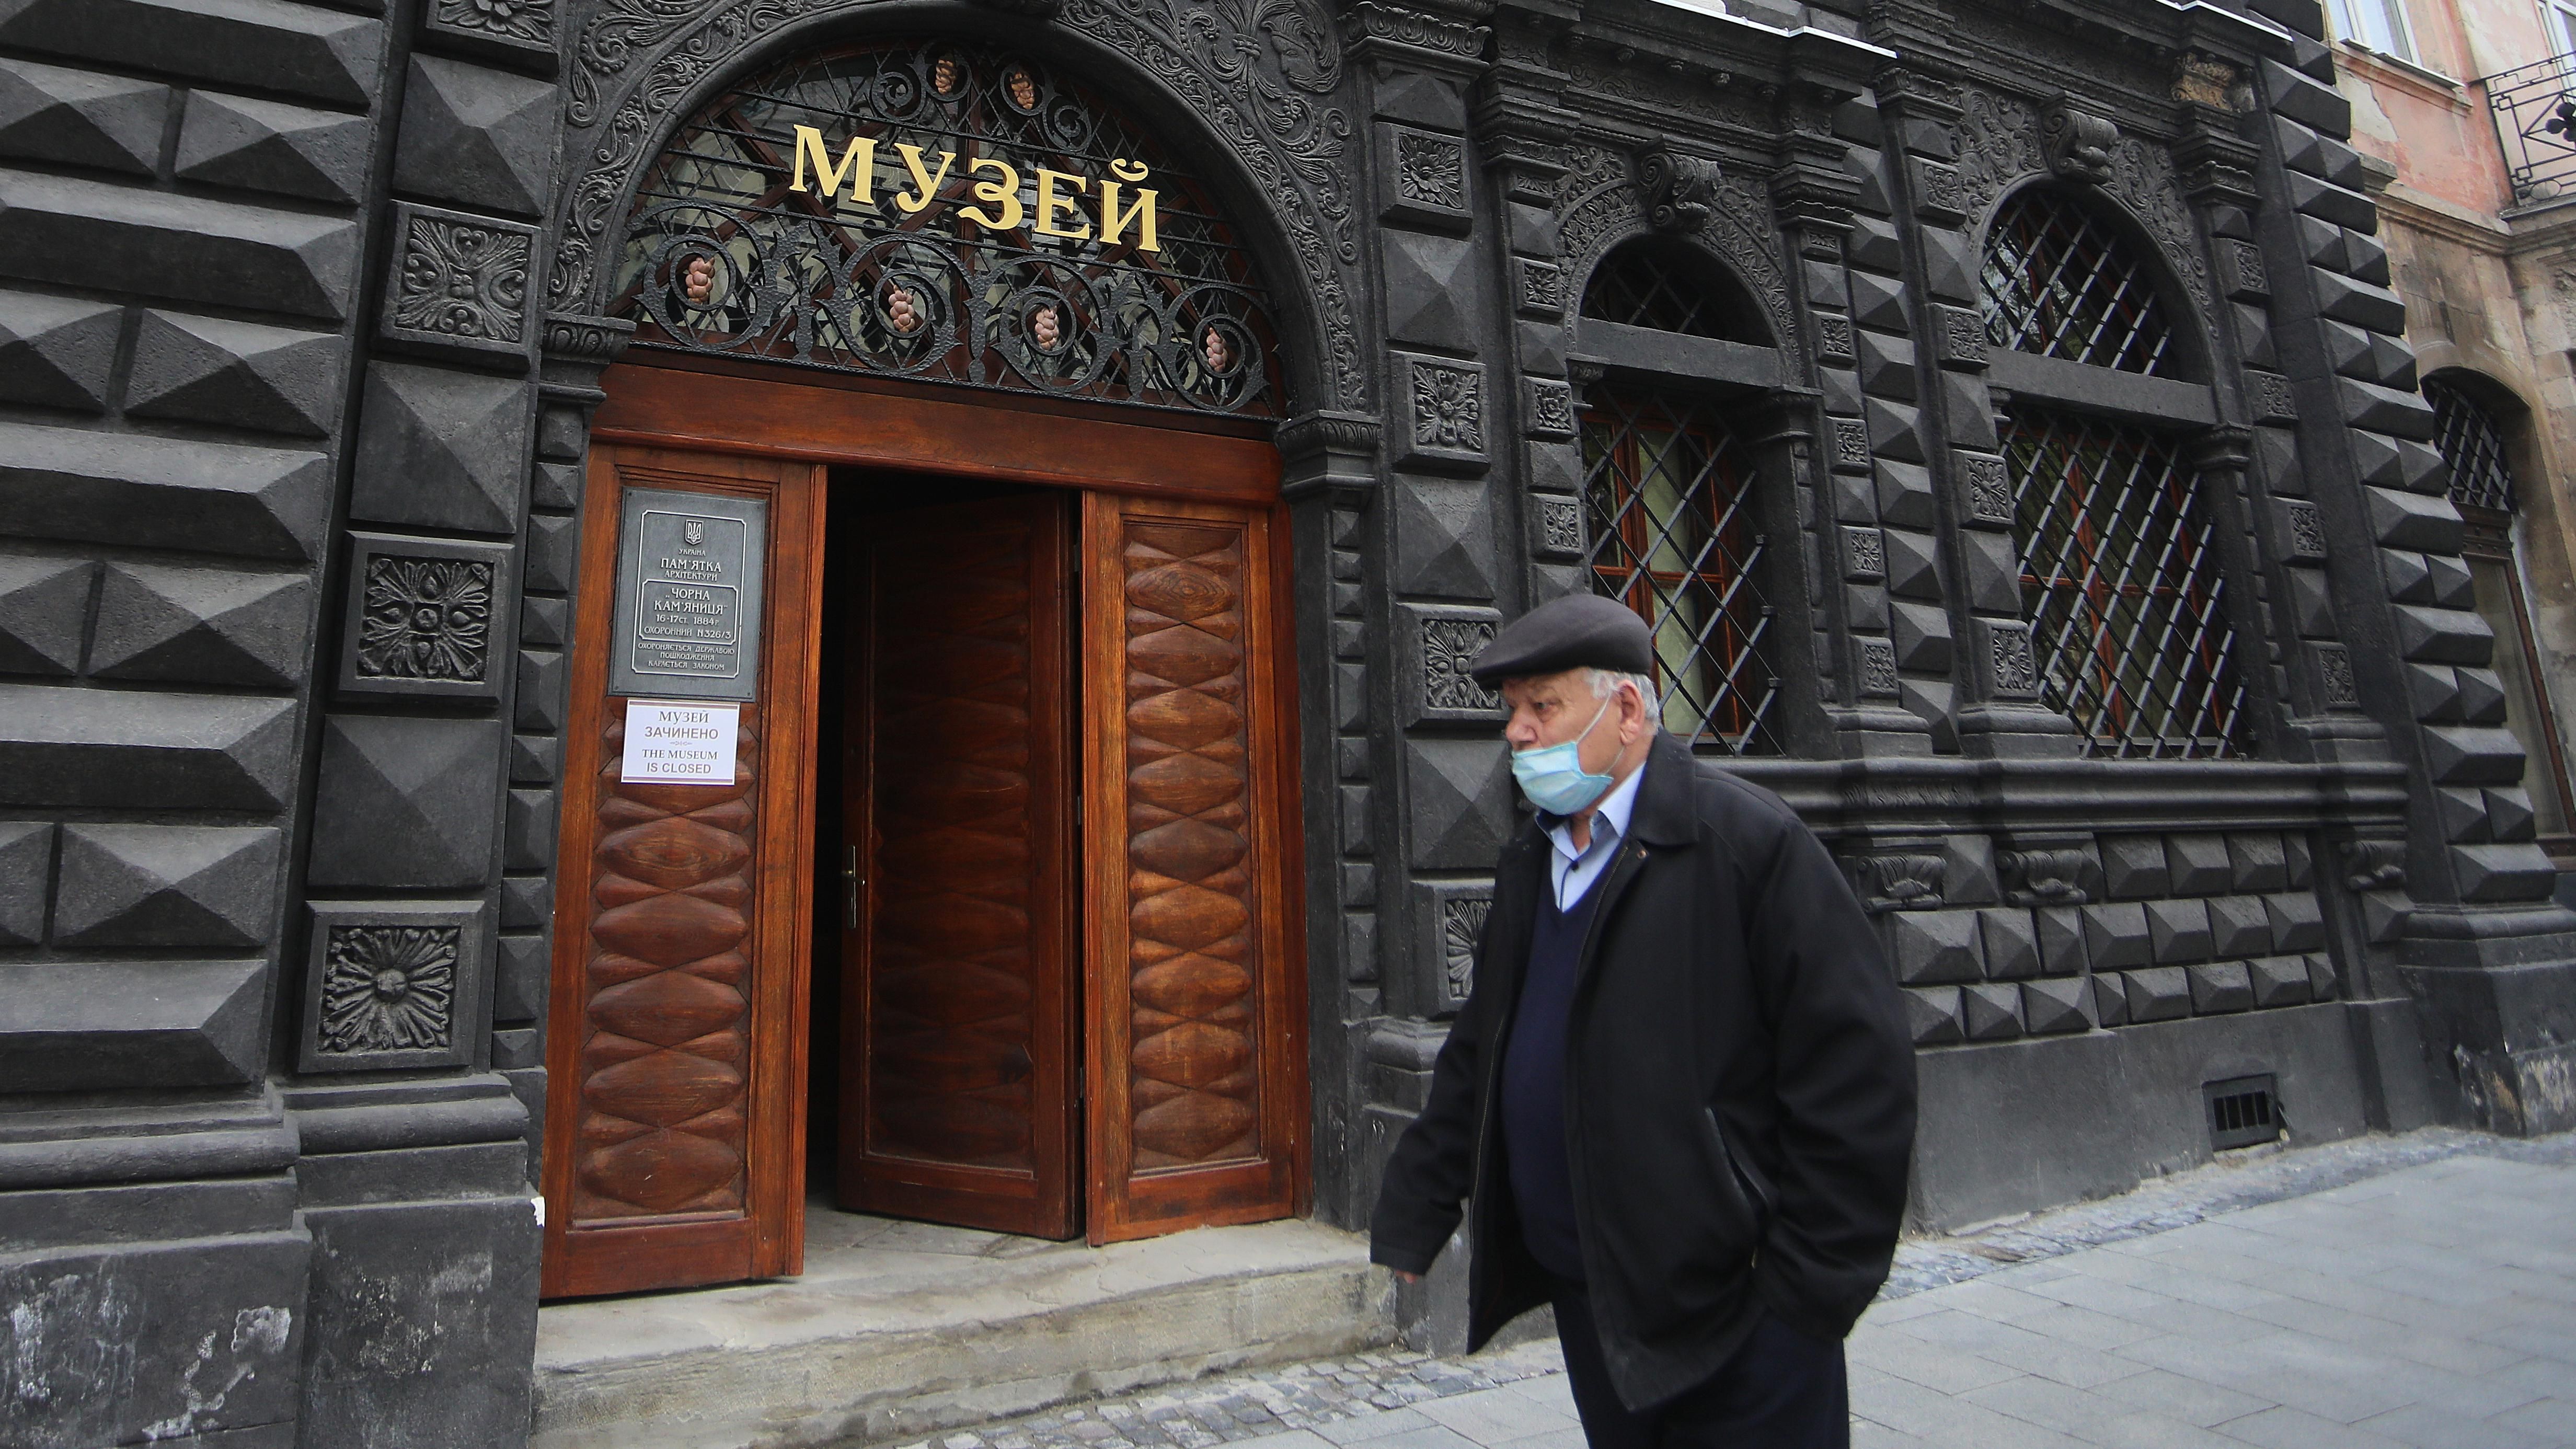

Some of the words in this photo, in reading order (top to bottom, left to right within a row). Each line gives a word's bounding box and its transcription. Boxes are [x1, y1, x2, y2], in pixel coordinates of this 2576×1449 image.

[789, 124, 1161, 252] МУЗЕЙ
[664, 570, 717, 581] АРХІТЕКТУРИ
[644, 626, 692, 637] ОХОРОННИЙ
[638, 642, 692, 651] ОХОРОНЯЄТЬСЯ
[695, 646, 734, 654] ДЕРЖАВОЮ
[660, 652, 715, 661] ПОШКОДЖЕННЯ
[693, 662, 724, 671] ЗАКОНОМ
[659, 710, 709, 724] МУЗЕЙ
[645, 726, 718, 739] ЗАЧИНЕНО
[642, 749, 665, 758] THE
[668, 750, 718, 760] MUSEUM
[647, 762, 658, 773] IS
[662, 763, 711, 774] CLOSED
